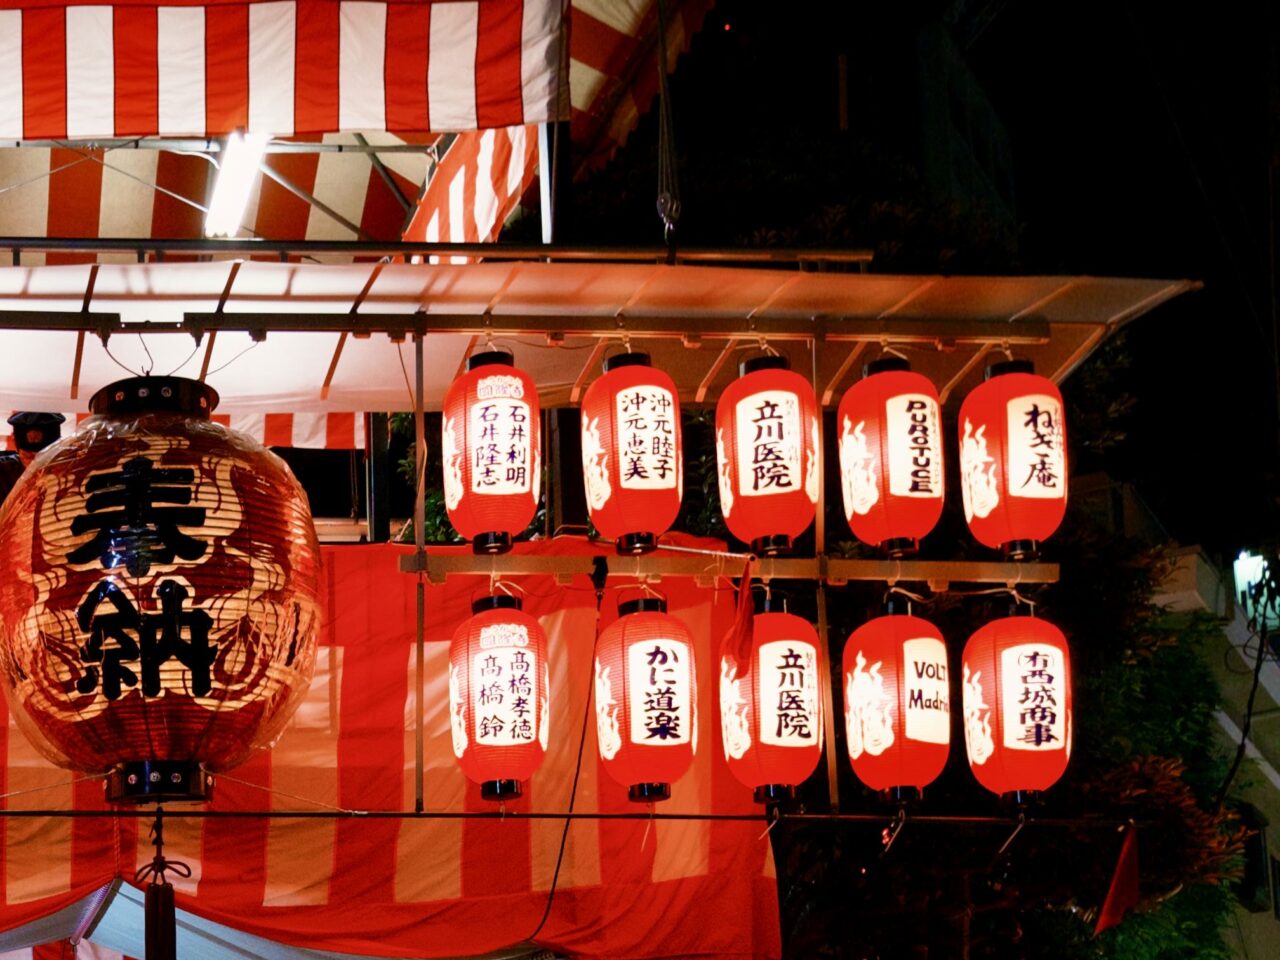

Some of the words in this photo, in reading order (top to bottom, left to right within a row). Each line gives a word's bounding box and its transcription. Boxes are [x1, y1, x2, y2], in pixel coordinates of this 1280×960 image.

[475, 404, 503, 488] 石井隆志
[505, 405, 527, 487] 石井利明
[622, 392, 650, 481] 沖元恵美
[650, 393, 674, 480] 沖元睦子
[751, 400, 793, 491] 立川医院
[66, 456, 220, 699] 奉納
[643, 645, 682, 741] かに道楽
[775, 648, 812, 739] 立川医院
